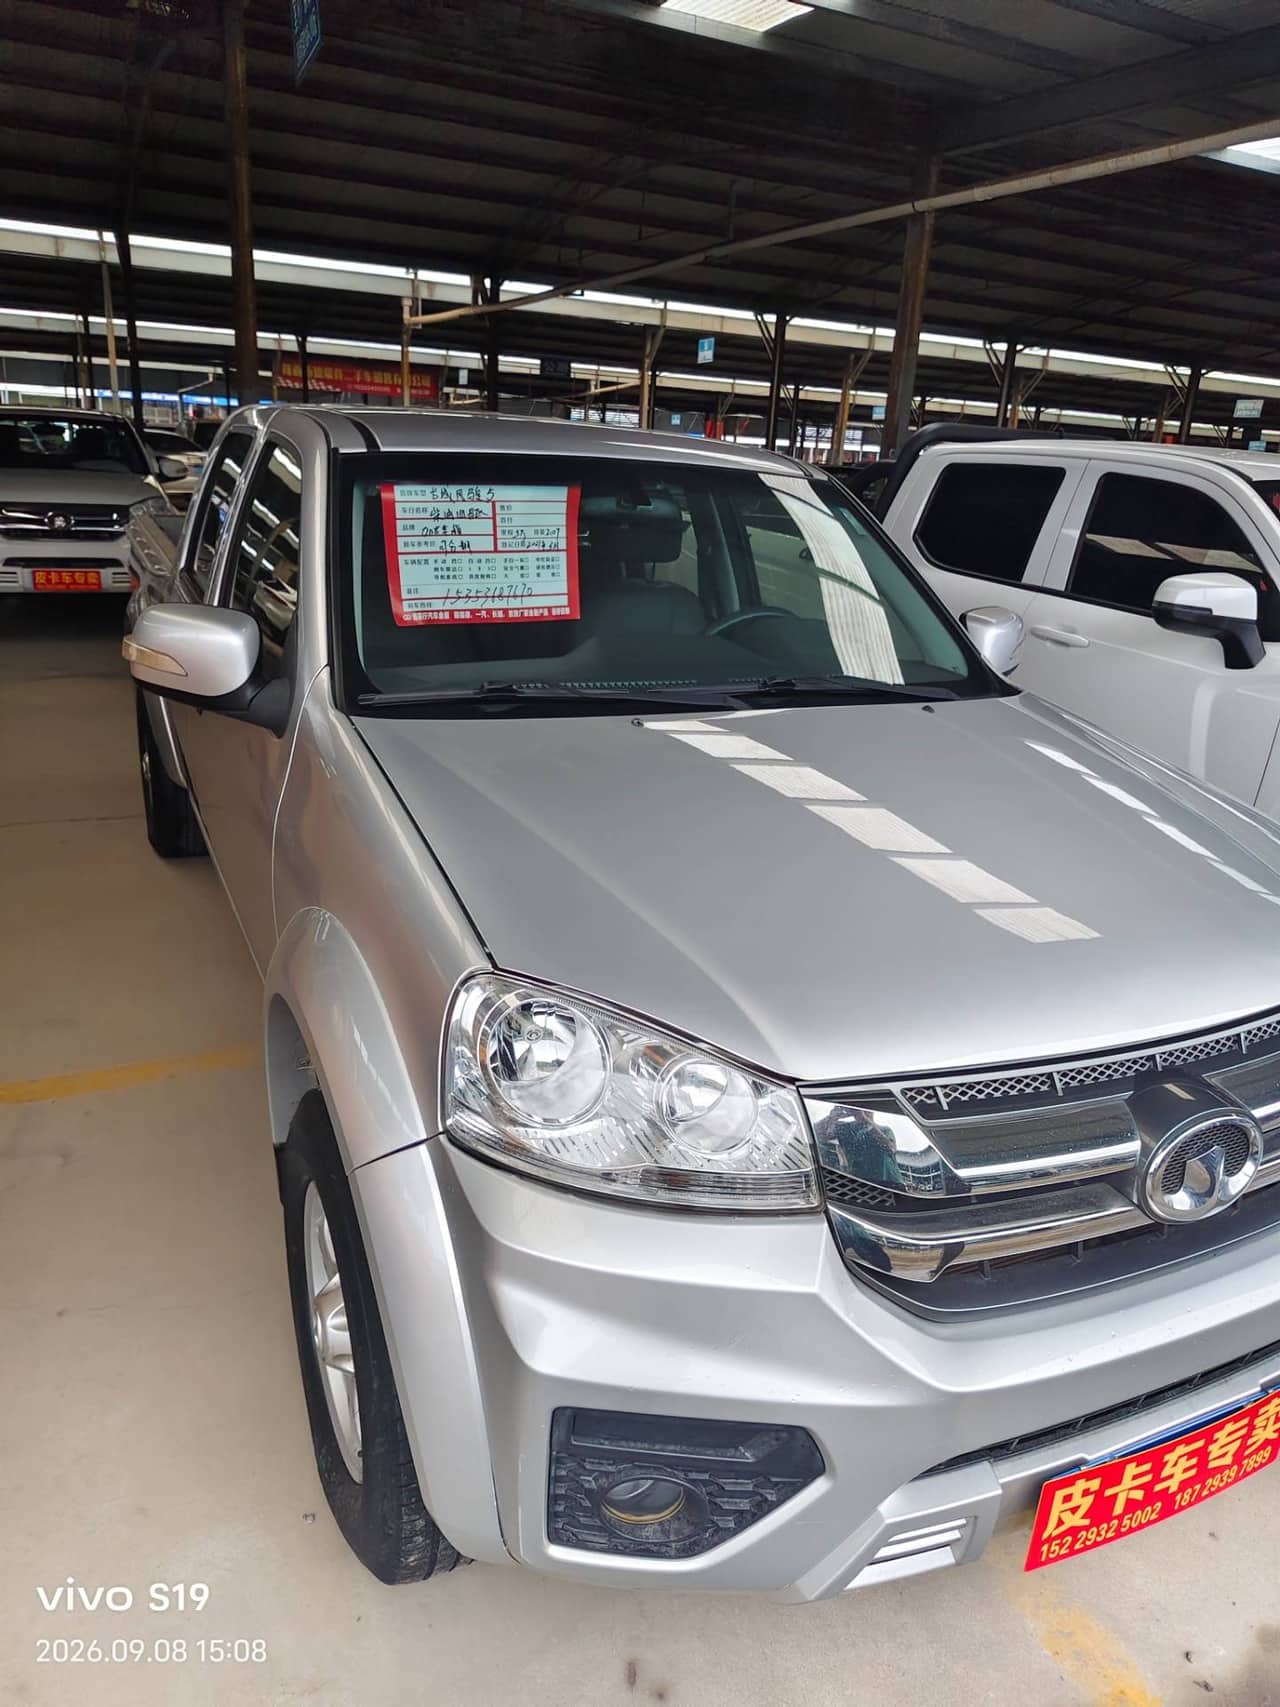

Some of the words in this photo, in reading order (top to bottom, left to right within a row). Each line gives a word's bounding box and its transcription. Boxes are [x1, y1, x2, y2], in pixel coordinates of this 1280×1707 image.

[1040, 1535, 1072, 1562] 152
[1074, 1521, 1117, 1549] 2932
[1121, 1502, 1162, 1532] 5002
[1174, 1484, 1201, 1511] 187
[1201, 1466, 1238, 1498] 2939
[1239, 1445, 1272, 1476] 7899
[1042, 1396, 1280, 1540] 皮卡车专卖
